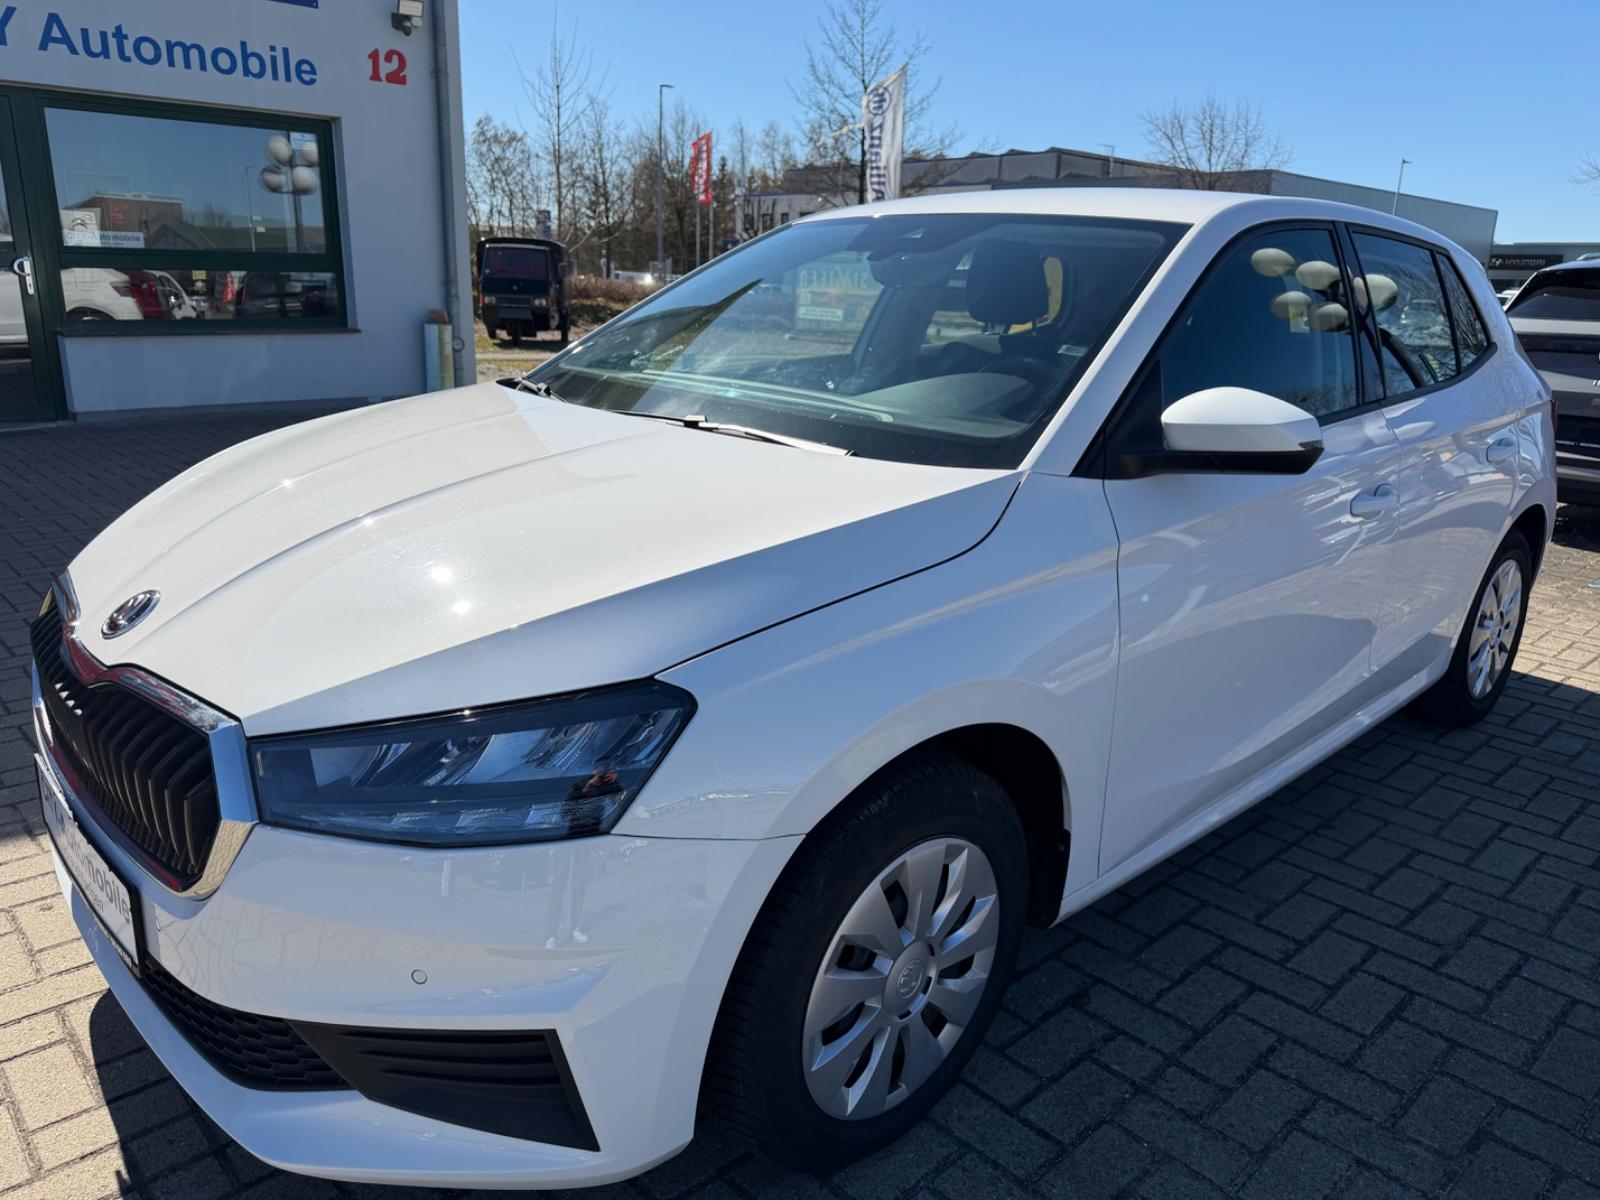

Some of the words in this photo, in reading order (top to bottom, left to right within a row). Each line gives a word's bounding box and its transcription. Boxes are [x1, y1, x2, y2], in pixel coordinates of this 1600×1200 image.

[38, 12, 317, 86] Automobile
[368, 48, 407, 86] 12
[1505, 258, 1546, 266] HYUNDAI
